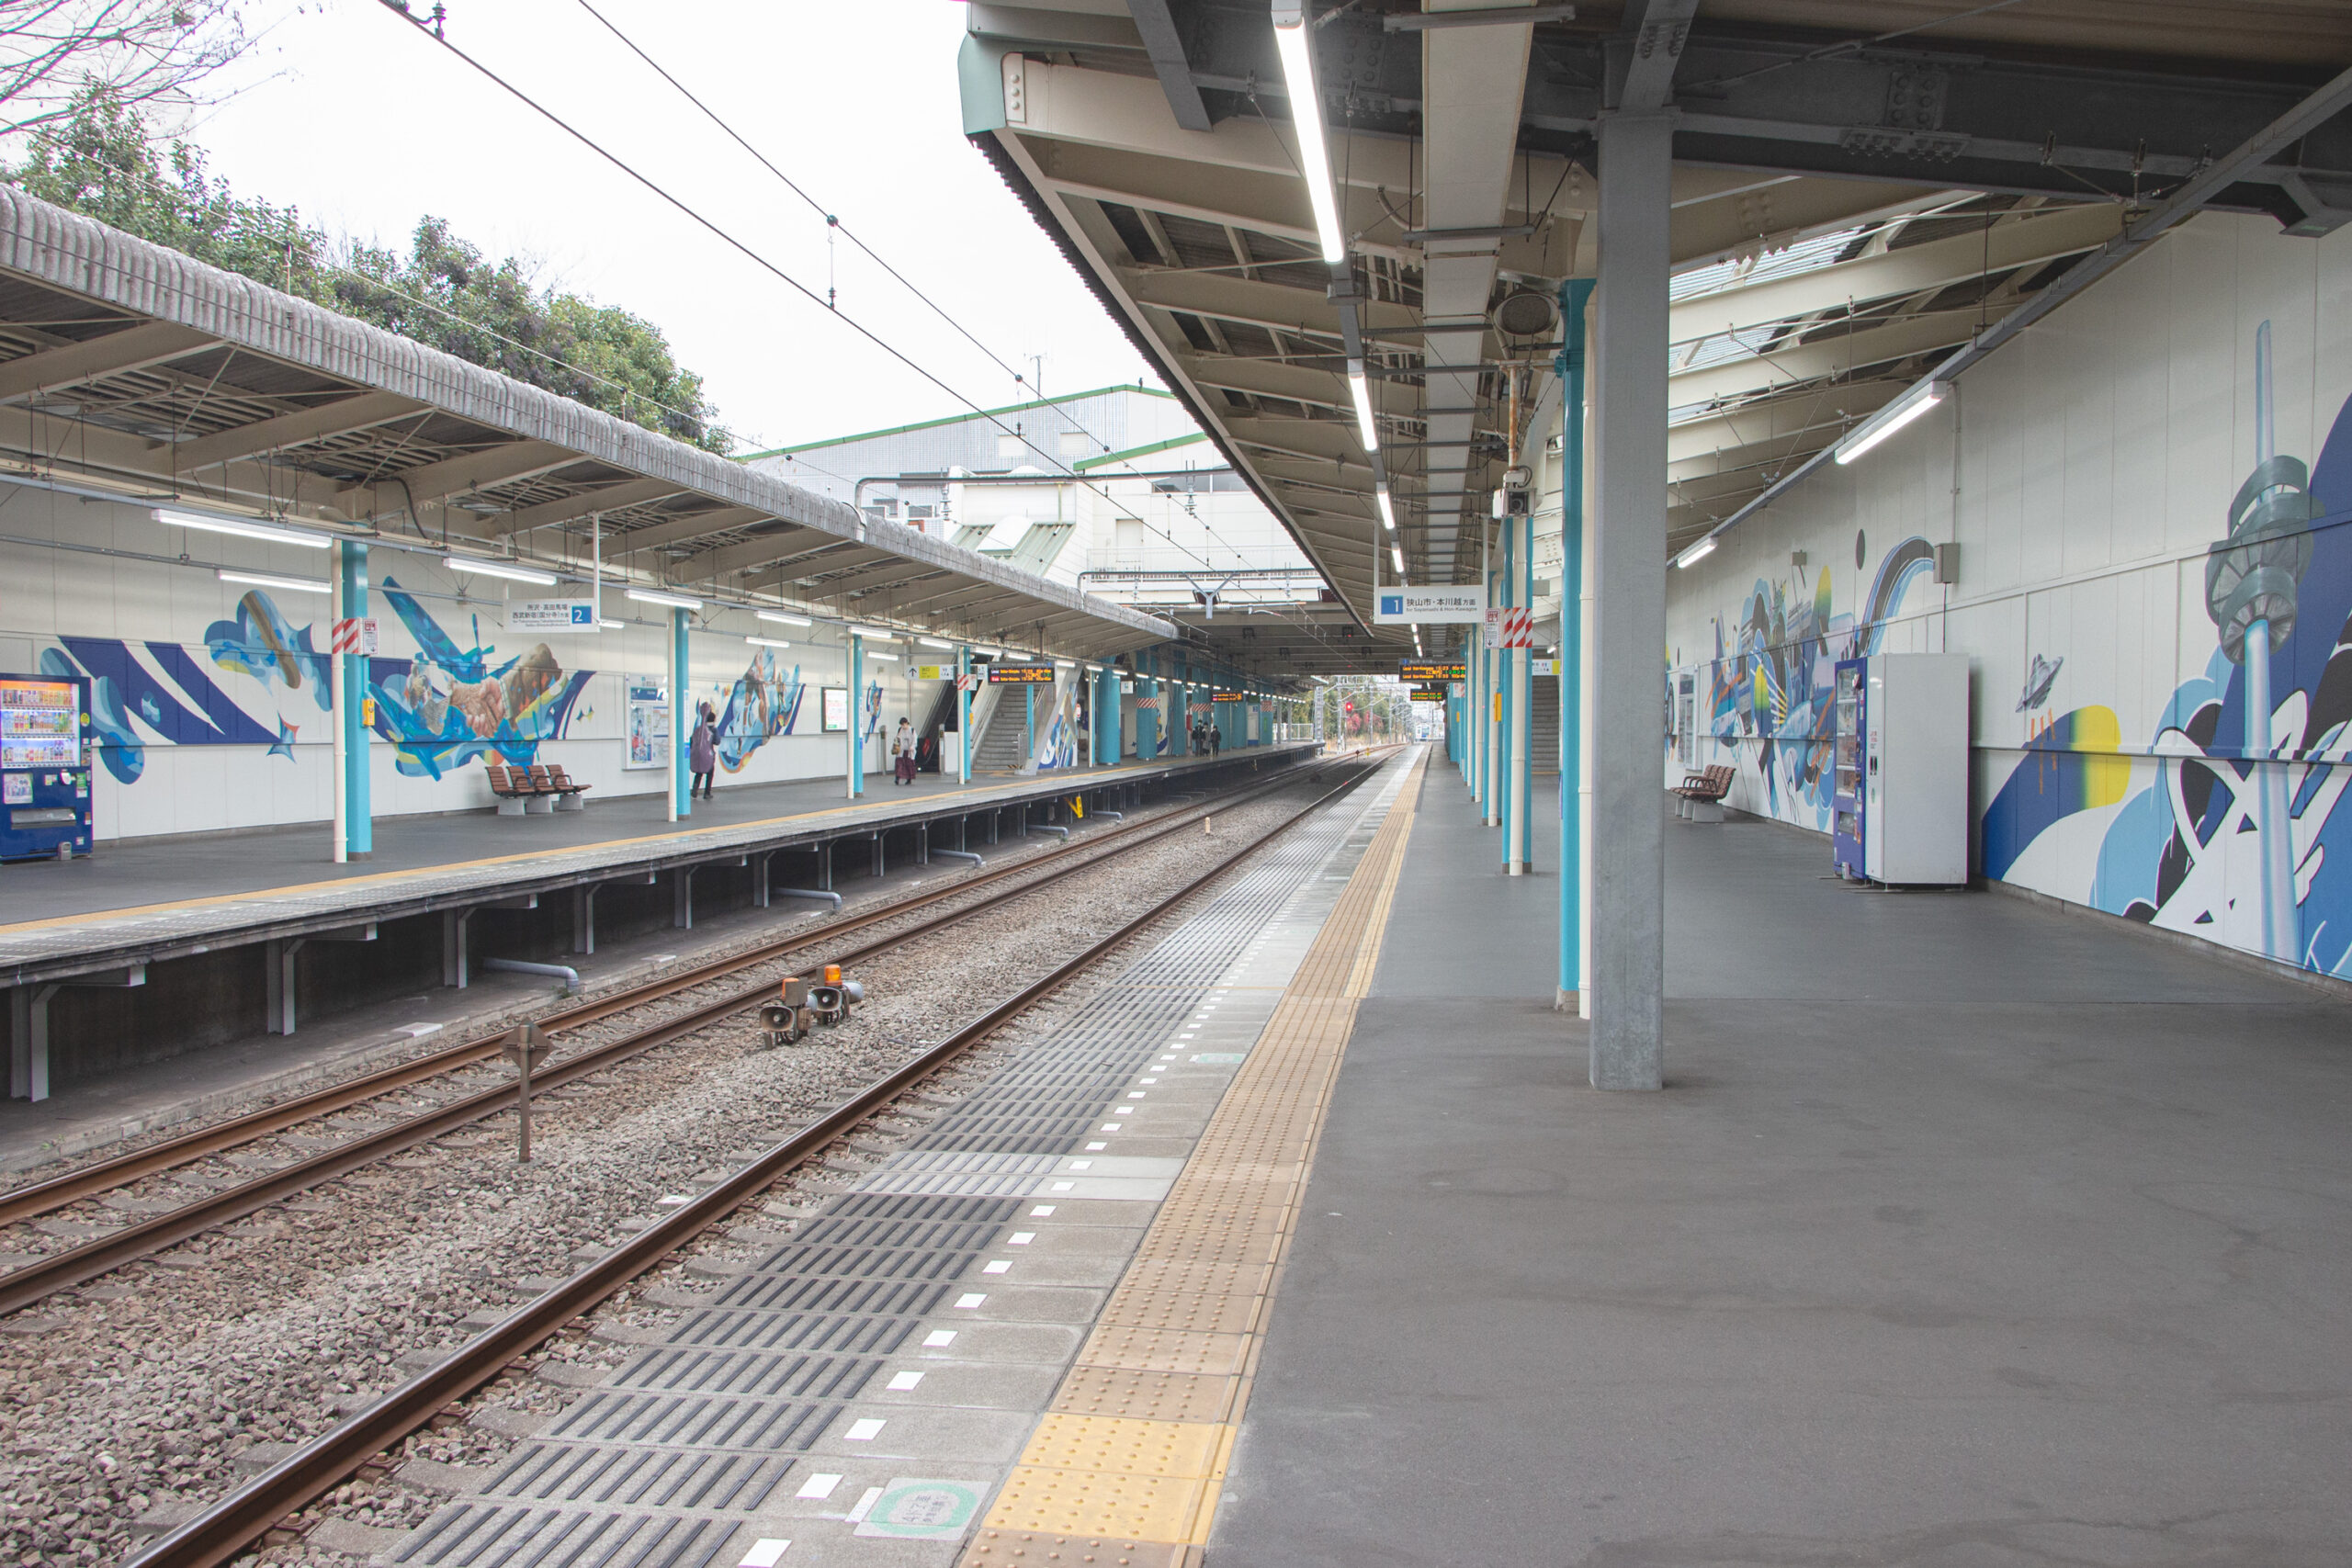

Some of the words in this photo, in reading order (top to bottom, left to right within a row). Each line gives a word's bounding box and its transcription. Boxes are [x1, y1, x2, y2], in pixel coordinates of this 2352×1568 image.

[1394, 599, 1399, 613] 1
[1406, 597, 1476, 607] 狭山市・本川越方面
[573, 609, 583, 622] 2
